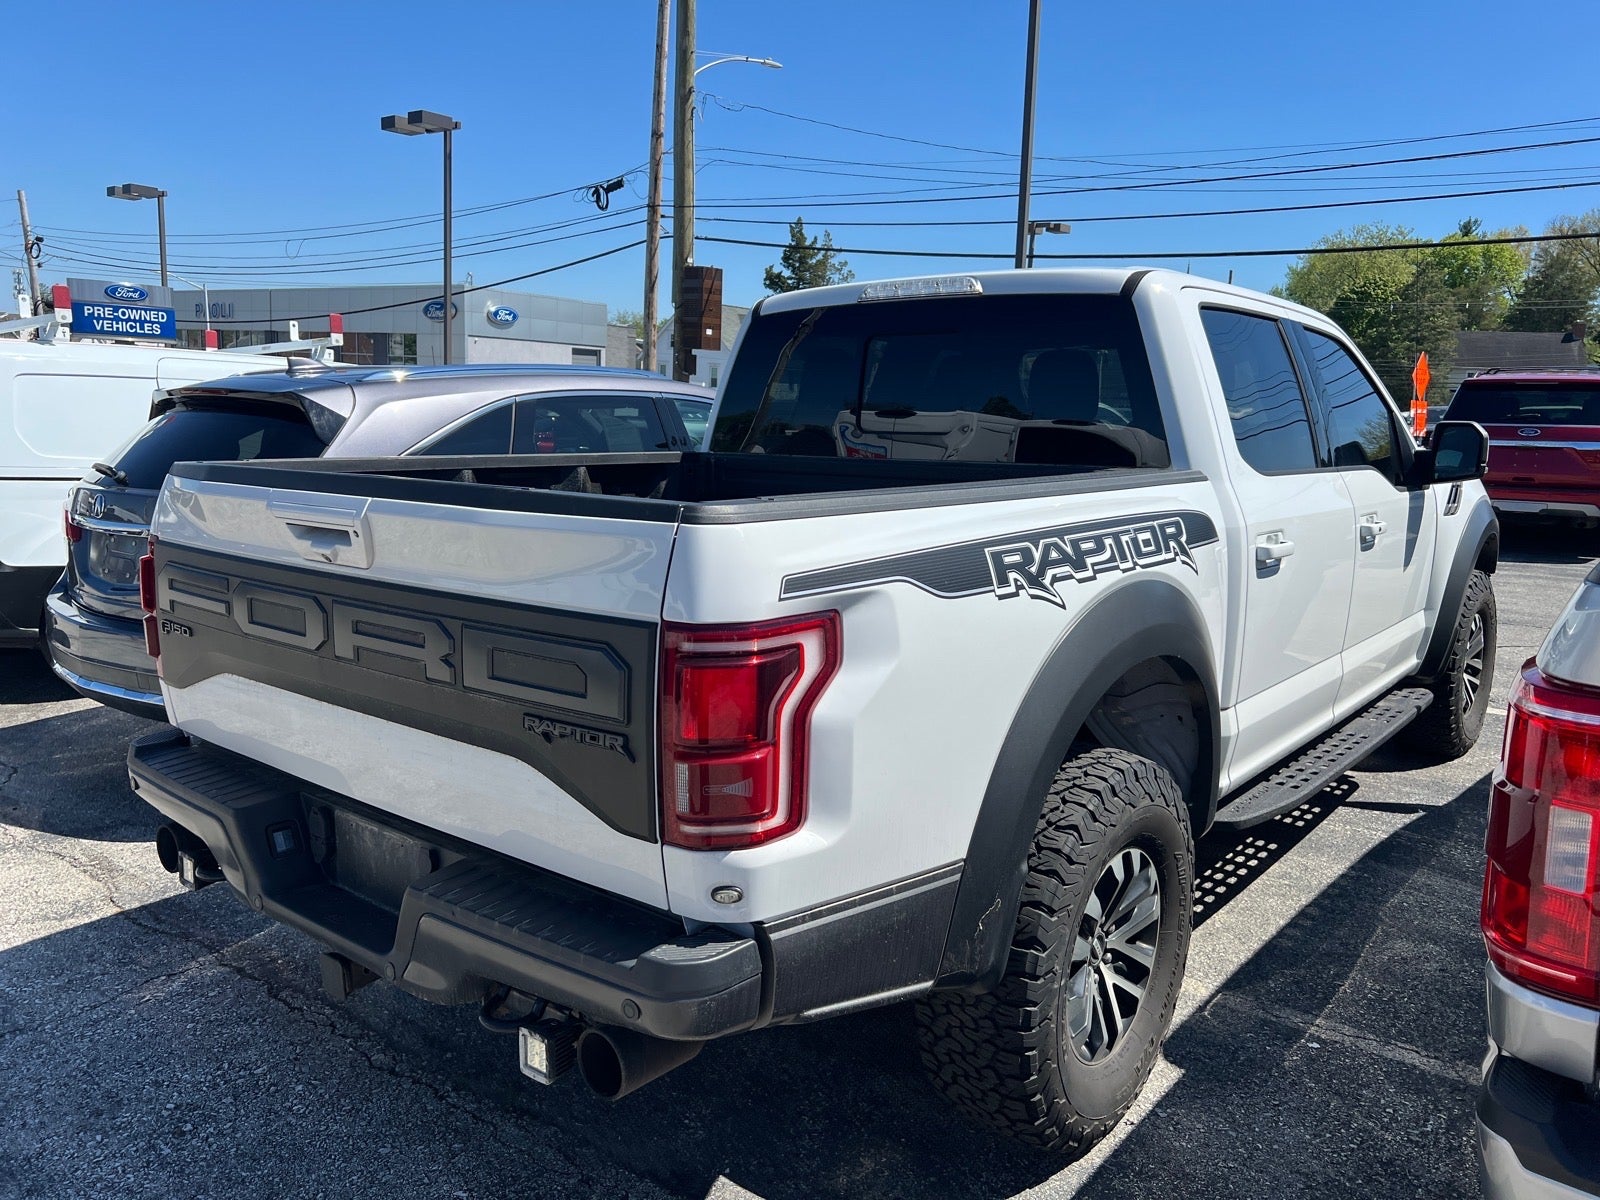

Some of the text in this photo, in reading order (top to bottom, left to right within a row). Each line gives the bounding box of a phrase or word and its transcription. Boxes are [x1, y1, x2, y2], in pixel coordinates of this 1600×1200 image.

[115, 287, 140, 298] Ford
[83, 305, 167, 322] PRE-OWNED
[496, 309, 514, 321] Ford
[93, 319, 161, 335] VEHICLES
[984, 517, 1199, 610] RAPTOR
[158, 561, 631, 727] FORD
[523, 713, 636, 763] RAPTOR
